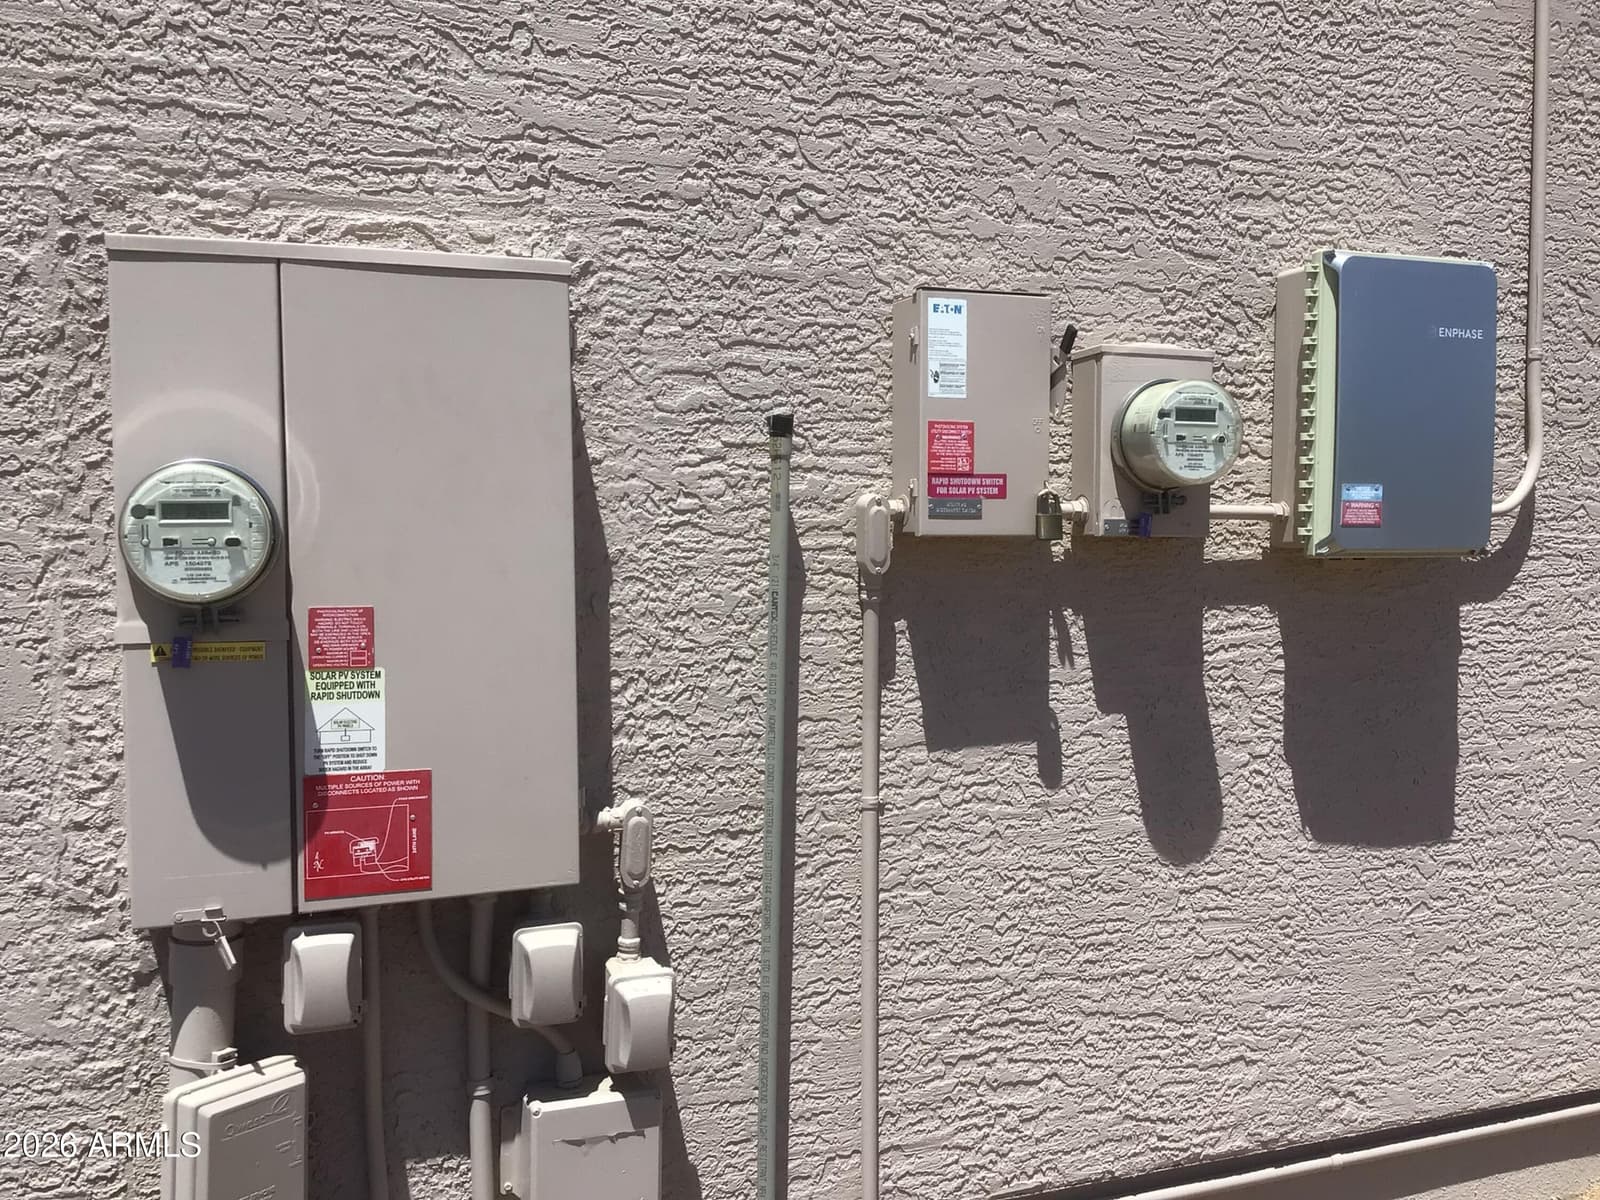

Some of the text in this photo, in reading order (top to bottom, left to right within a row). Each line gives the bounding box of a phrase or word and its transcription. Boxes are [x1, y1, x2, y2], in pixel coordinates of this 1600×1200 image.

[1438, 328, 1484, 340] ENPHASE
[310, 672, 336, 680] SOLAR
[351, 670, 381, 679] SYSTEM
[316, 682, 354, 690] EQUIPPED
[311, 691, 380, 700] RAPID SHUTDOWN
[350, 774, 385, 782] CAUTION
